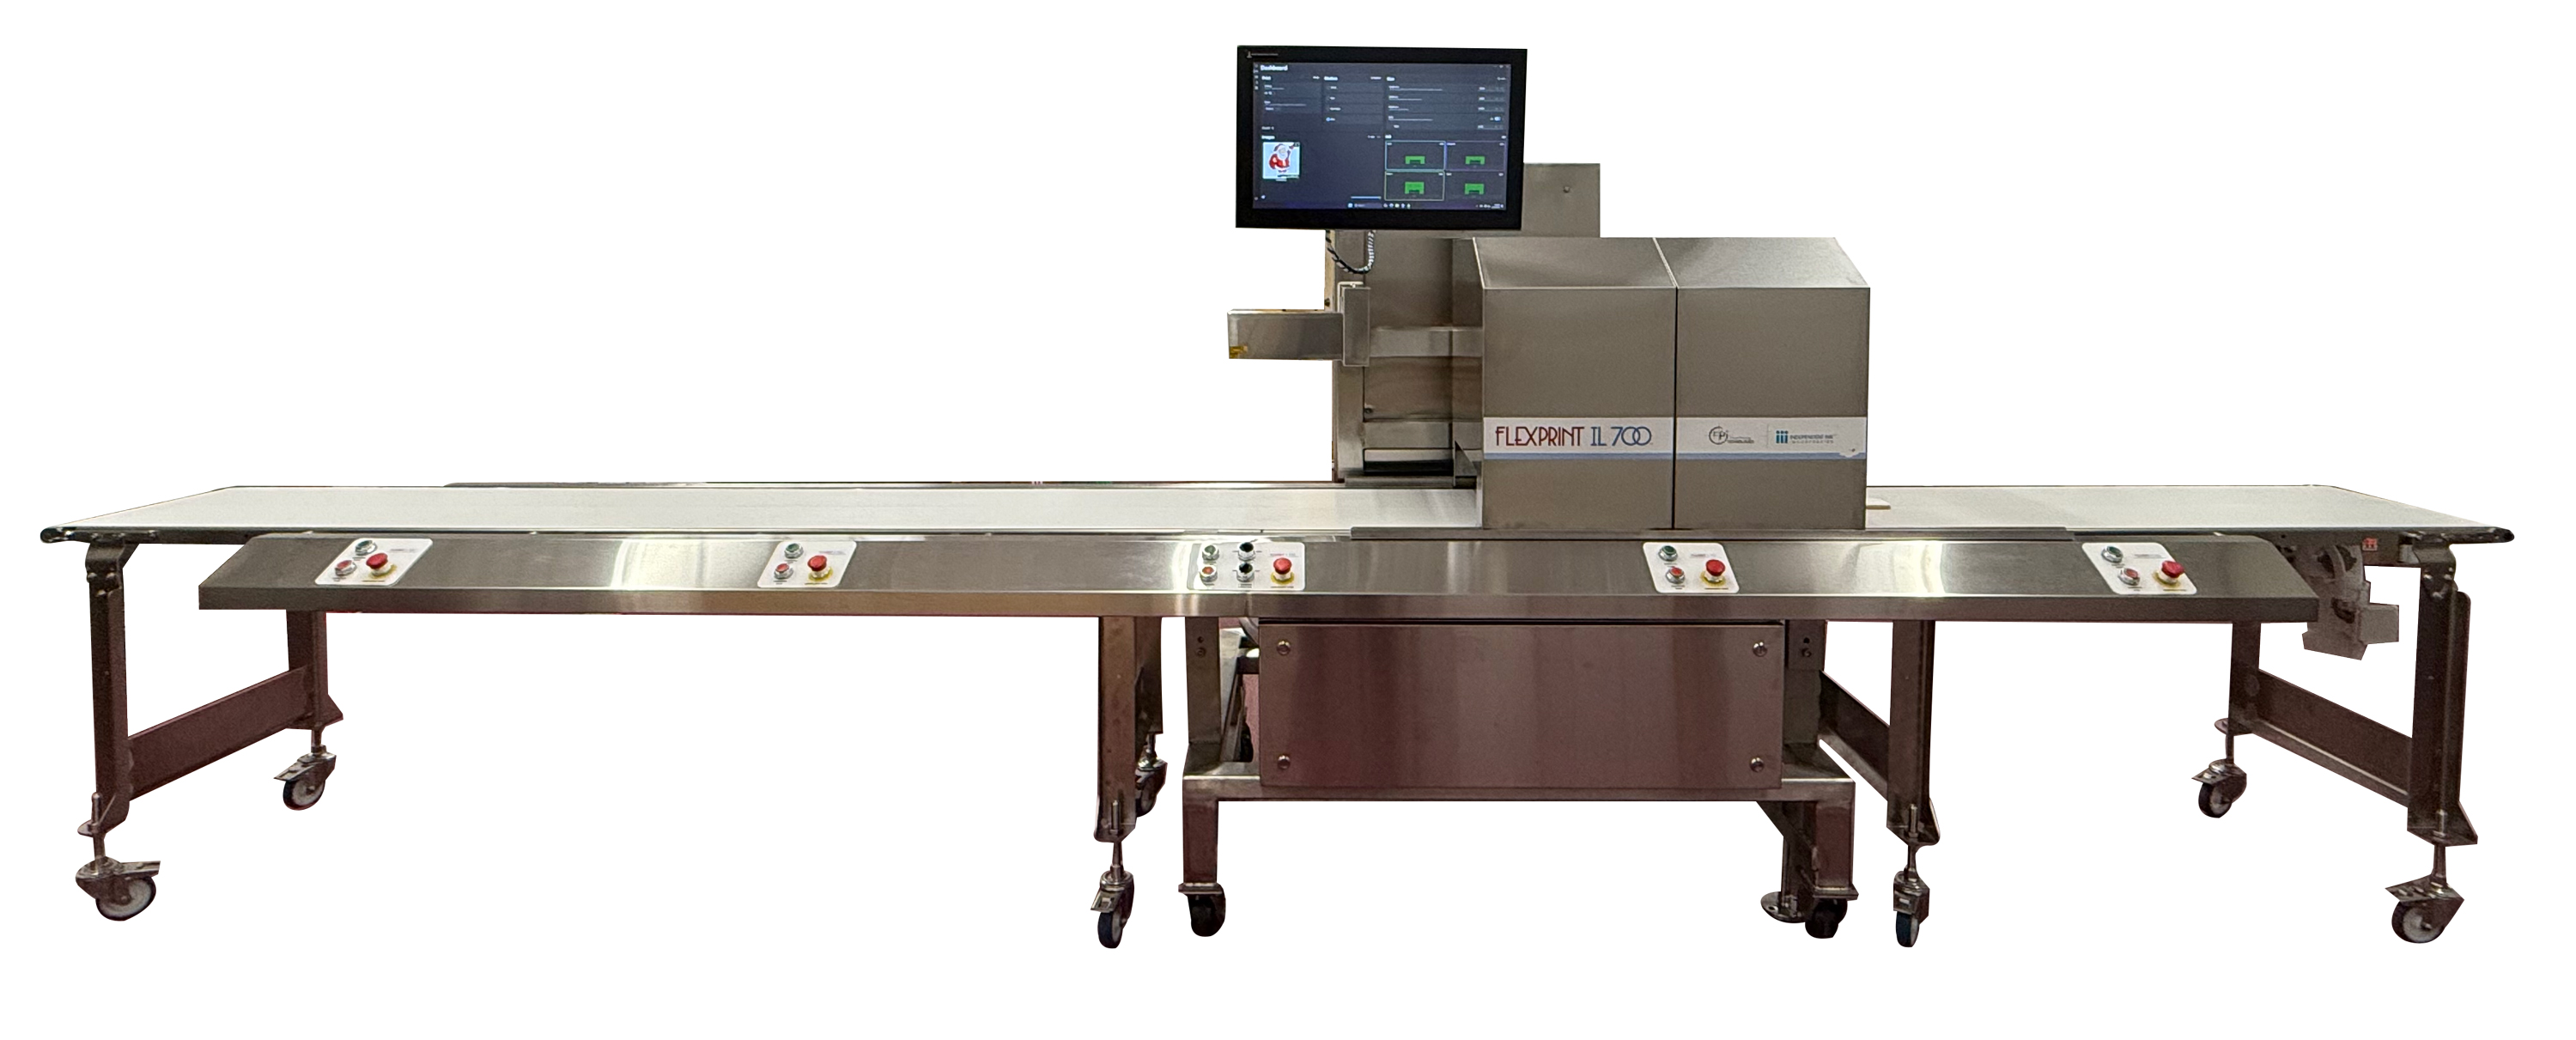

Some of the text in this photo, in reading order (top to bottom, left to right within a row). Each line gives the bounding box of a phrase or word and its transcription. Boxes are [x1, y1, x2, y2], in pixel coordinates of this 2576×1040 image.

[1495, 426, 1652, 447] FLEXPRINT IL 700
